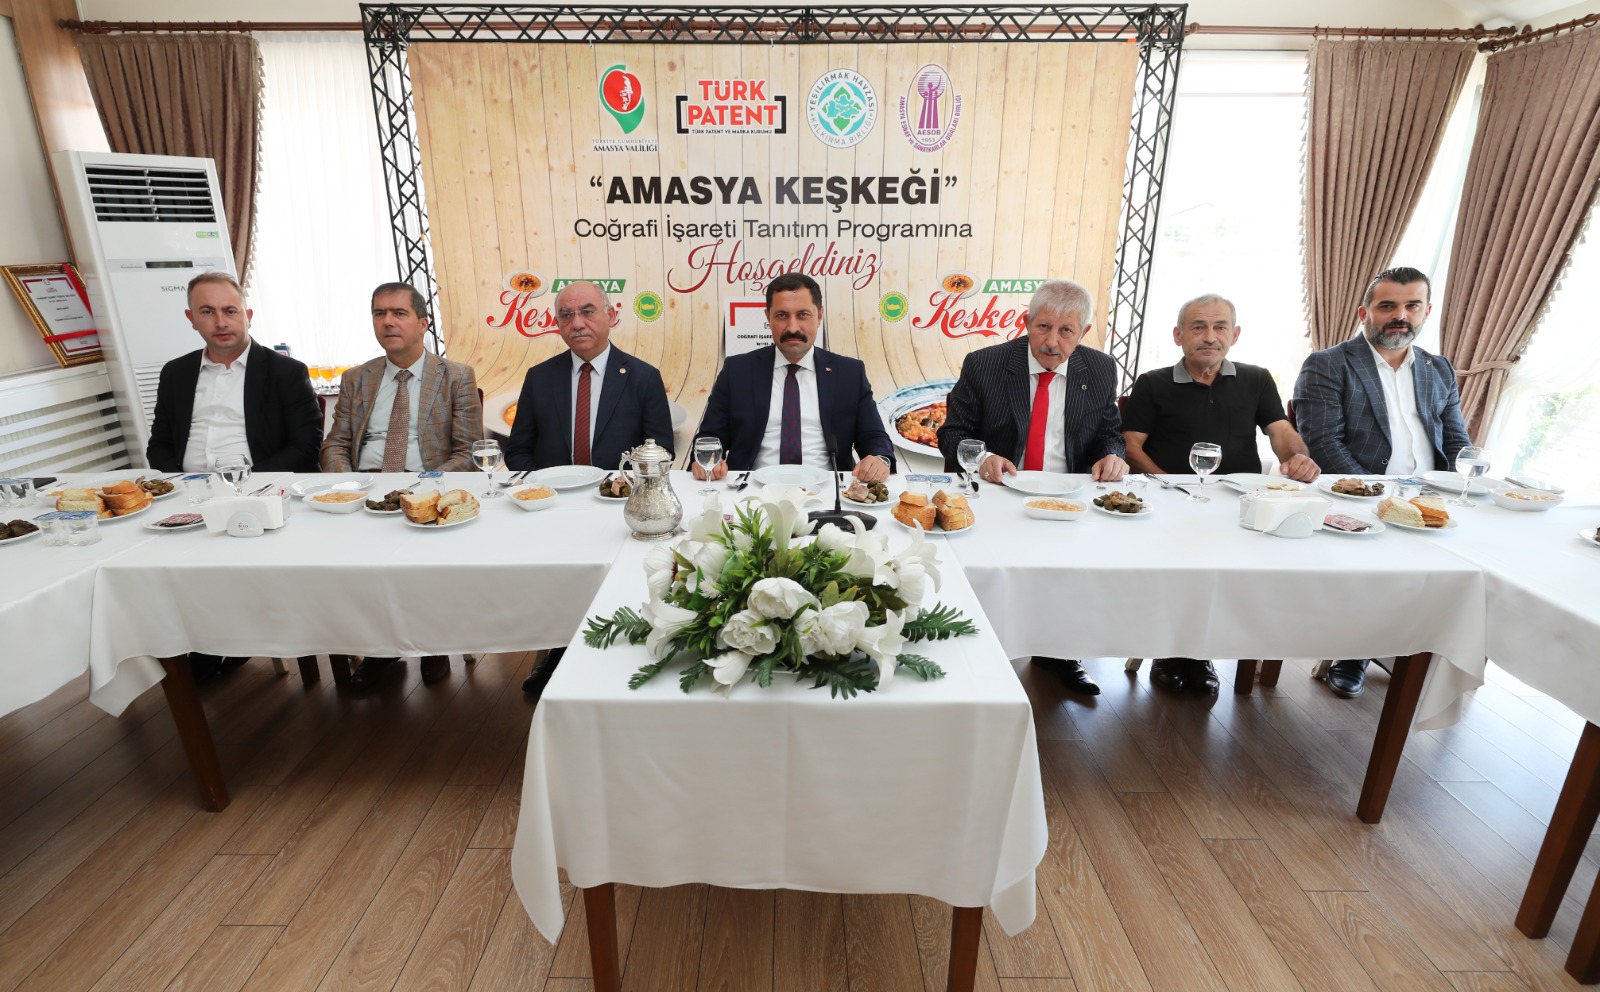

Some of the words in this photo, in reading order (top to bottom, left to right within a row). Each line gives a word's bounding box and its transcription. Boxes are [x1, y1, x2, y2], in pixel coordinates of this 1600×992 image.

[698, 80, 766, 101] TÜRK
[852, 75, 874, 112] HAVZASI
[688, 105, 778, 126] PATENT
[810, 117, 846, 145] KALKINMA
[574, 218, 658, 241] Coğrafi
[666, 214, 736, 242] İşareti
[744, 218, 828, 238] Tanıtım
[838, 218, 972, 242] Programına
